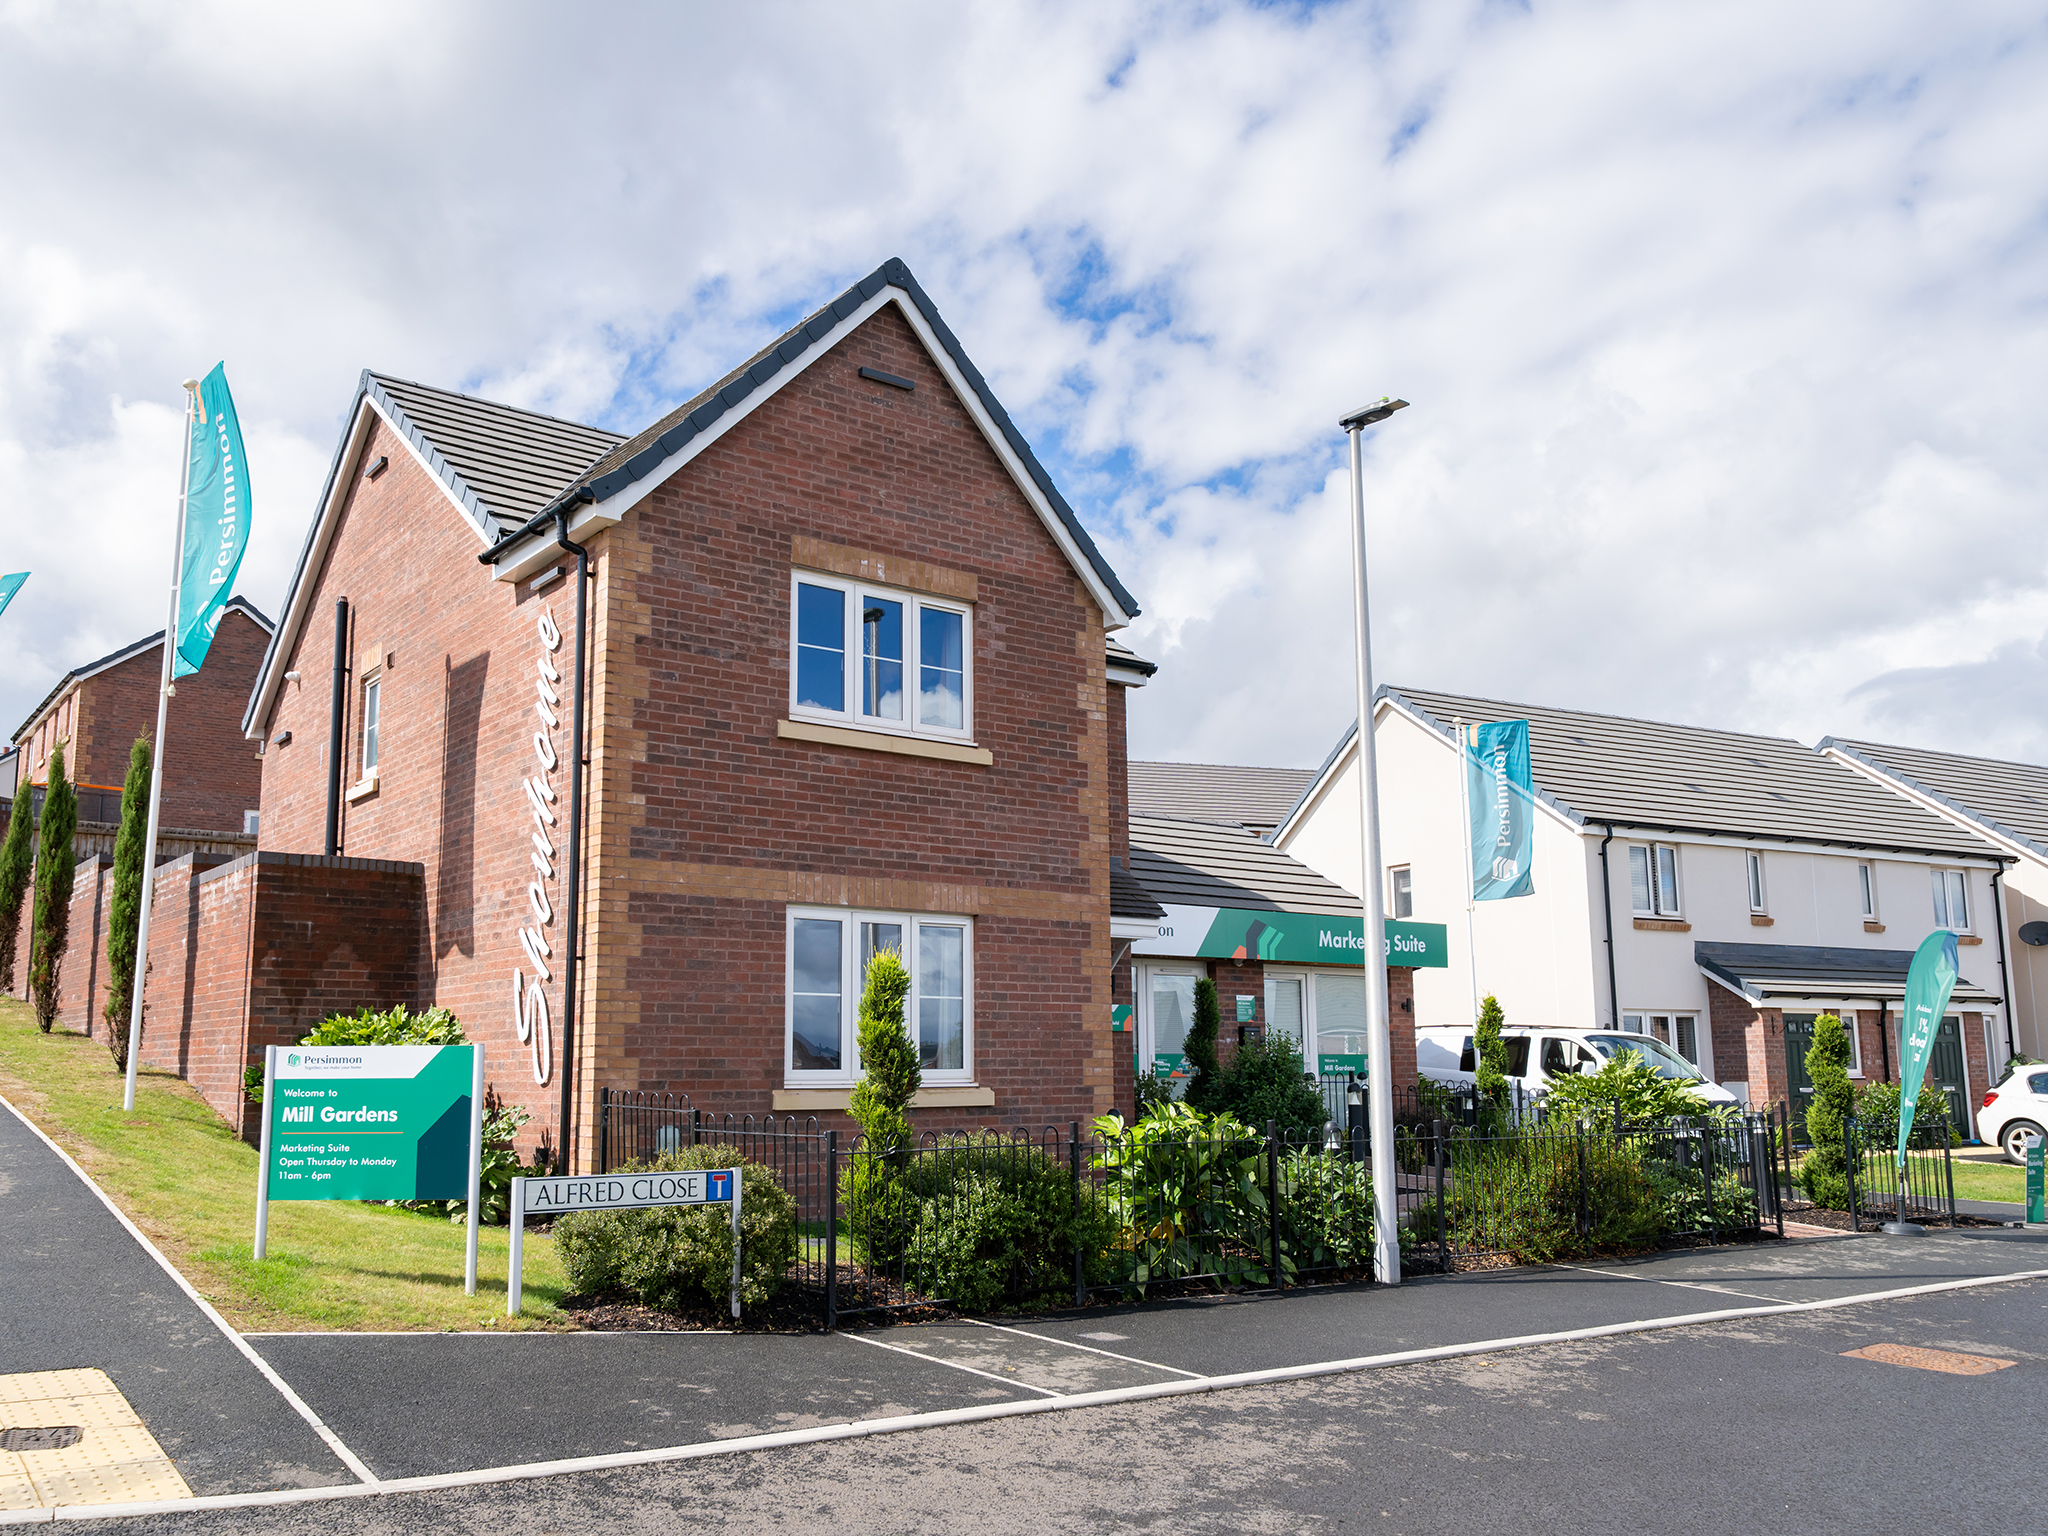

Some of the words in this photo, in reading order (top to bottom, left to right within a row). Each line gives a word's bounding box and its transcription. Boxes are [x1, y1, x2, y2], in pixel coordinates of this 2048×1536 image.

[209, 412, 236, 585] Persimmon
[1494, 745, 1511, 847] Persimmon
[514, 603, 560, 1086] Showhome
[1319, 930, 1391, 956] Markeg
[1394, 934, 1427, 953] Suite
[304, 1055, 363, 1064] Persimmon
[284, 1089, 325, 1098] Welcome
[328, 1089, 338, 1098] to
[281, 1106, 315, 1123] Mill
[320, 1105, 399, 1123] Gardens
[280, 1144, 325, 1154] Marketing
[327, 1143, 351, 1153] Suite
[279, 1157, 304, 1168] Open
[306, 1157, 347, 1168] Thursday
[349, 1158, 359, 1166] to
[361, 1157, 398, 1168] Monday
[279, 1171, 302, 1180] 11am
[311, 1171, 332, 1181] 6pm
[535, 1181, 624, 1206] ALFRED
[632, 1178, 699, 1200] CLOSE
